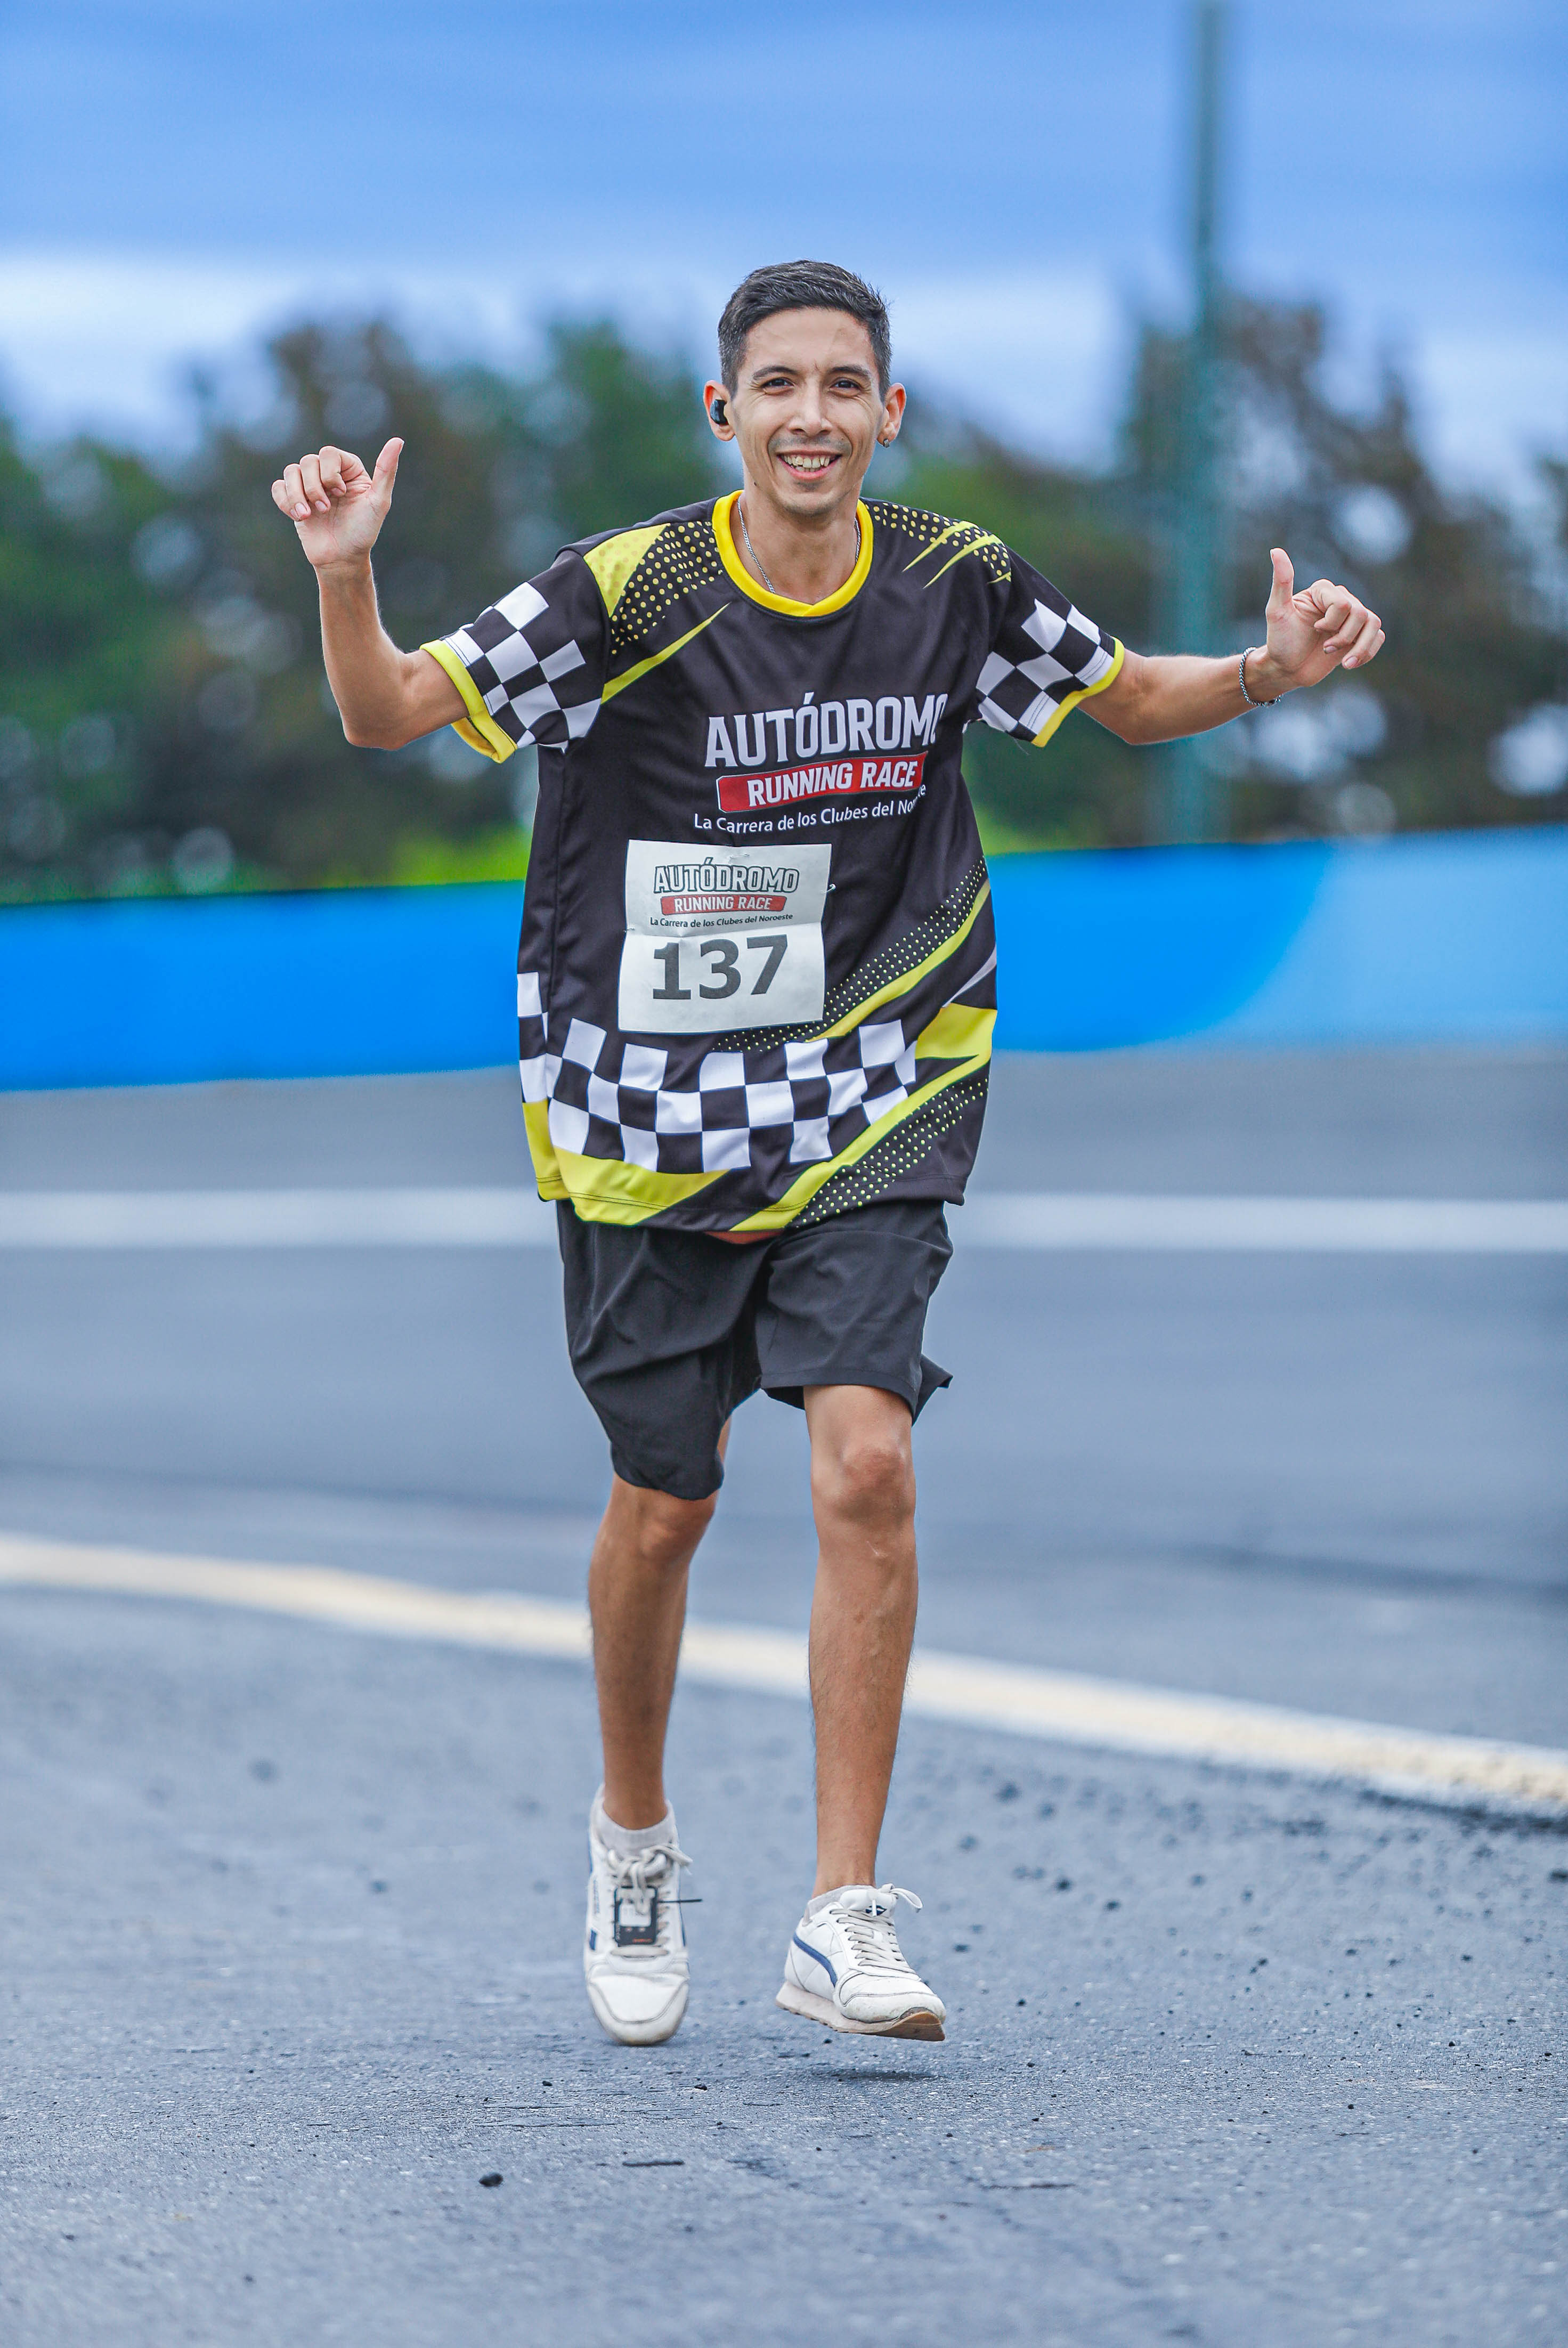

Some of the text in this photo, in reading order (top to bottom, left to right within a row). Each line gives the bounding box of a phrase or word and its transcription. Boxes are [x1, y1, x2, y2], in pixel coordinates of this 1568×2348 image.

[747, 760, 918, 807] RUNNING RACE
[694, 813, 712, 830] La
[716, 817, 773, 834] Carrera
[777, 815, 794, 831] de
[798, 812, 817, 827] los
[820, 807, 868, 824] Clubes
[872, 800, 894, 817] del
[653, 857, 800, 894] AUTÓDROMO
[650, 917, 659, 925] La
[660, 918, 688, 928] Carrera
[759, 913, 793, 922] Noroeste
[673, 896, 773, 913] RUNNING RACE
[653, 934, 788, 1000] 137
